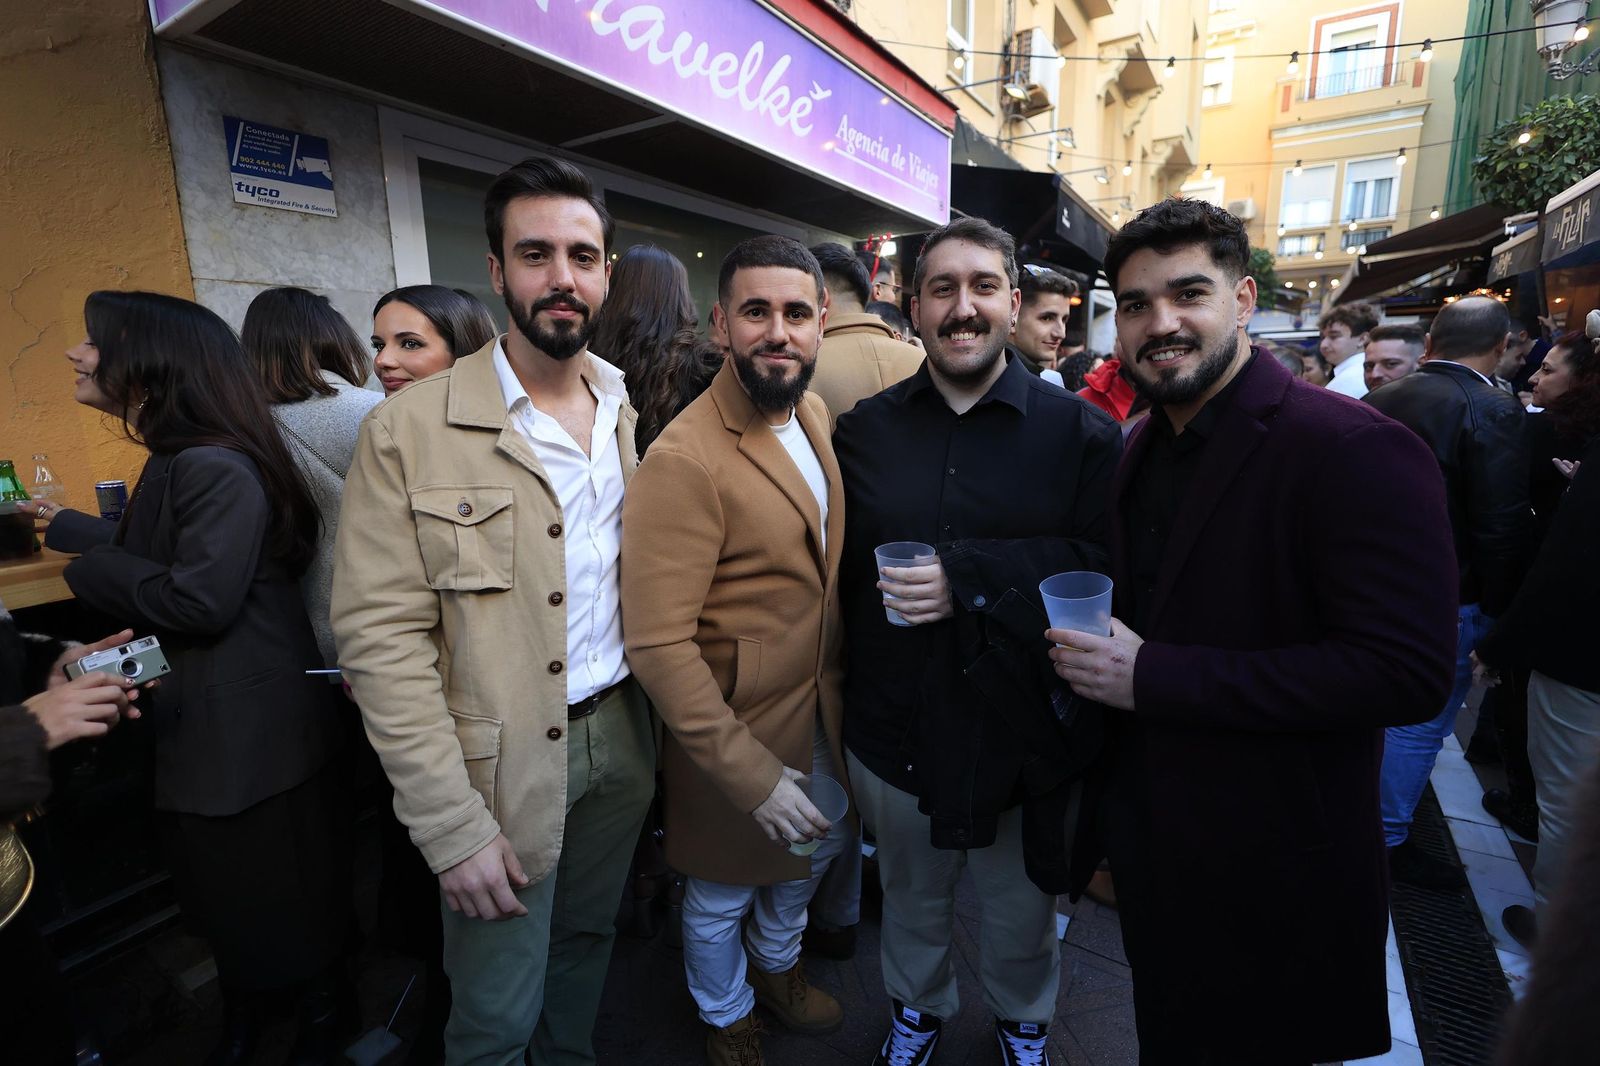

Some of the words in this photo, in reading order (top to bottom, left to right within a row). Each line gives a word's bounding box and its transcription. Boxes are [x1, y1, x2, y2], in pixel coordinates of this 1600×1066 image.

[245, 126, 290, 141] Conectada
[836, 114, 889, 163] Agencia
[891, 144, 906, 171] de
[909, 152, 939, 190] Viajes
[235, 181, 280, 198] tyco
[257, 196, 291, 207] Integrated
[292, 201, 303, 209] Fire
[311, 205, 335, 215] Security
